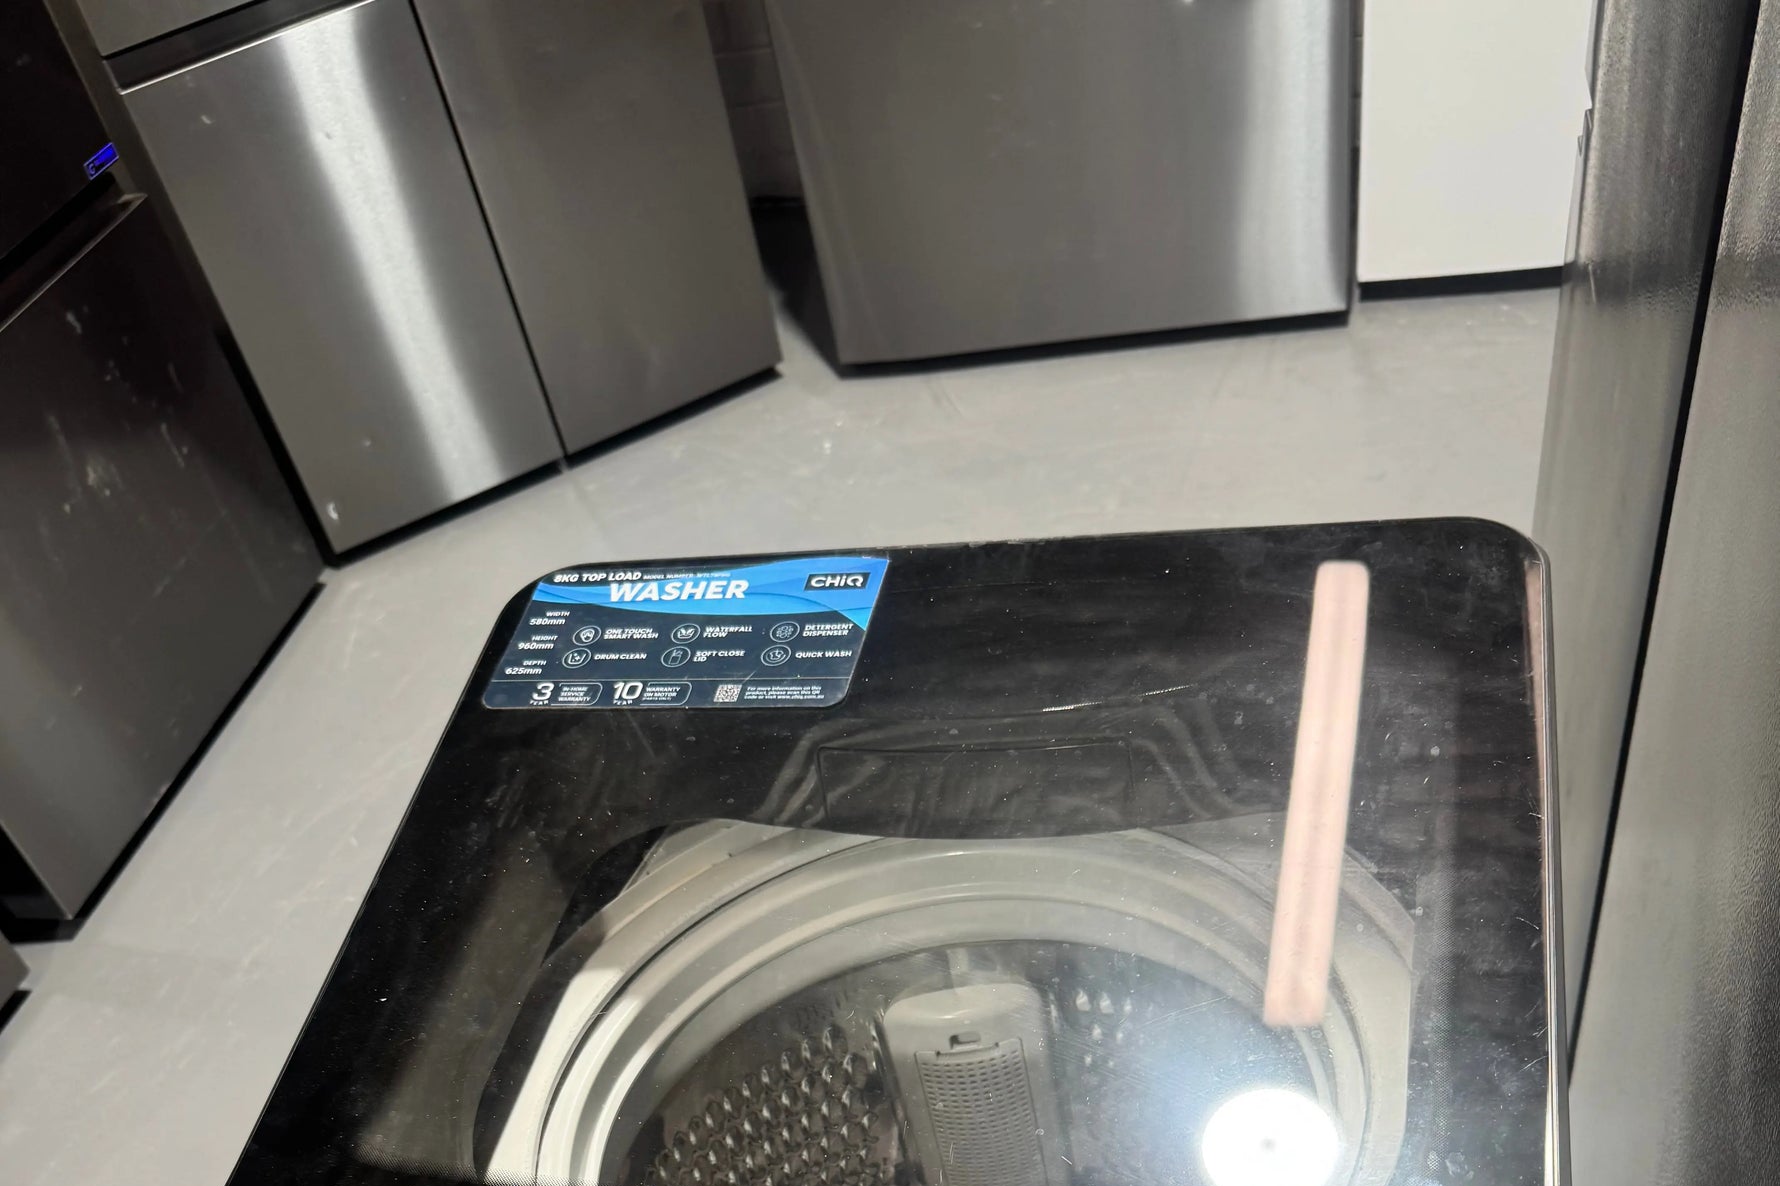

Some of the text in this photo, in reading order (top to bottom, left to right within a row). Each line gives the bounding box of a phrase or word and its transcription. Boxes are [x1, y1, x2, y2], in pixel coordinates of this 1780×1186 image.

[553, 572, 642, 583] 8KG TOP LOAD
[609, 580, 750, 602] WASHER
[518, 642, 554, 650] 960mm
[505, 667, 542, 675] 625mm
[532, 682, 554, 700] 3
[613, 682, 644, 700] 10
